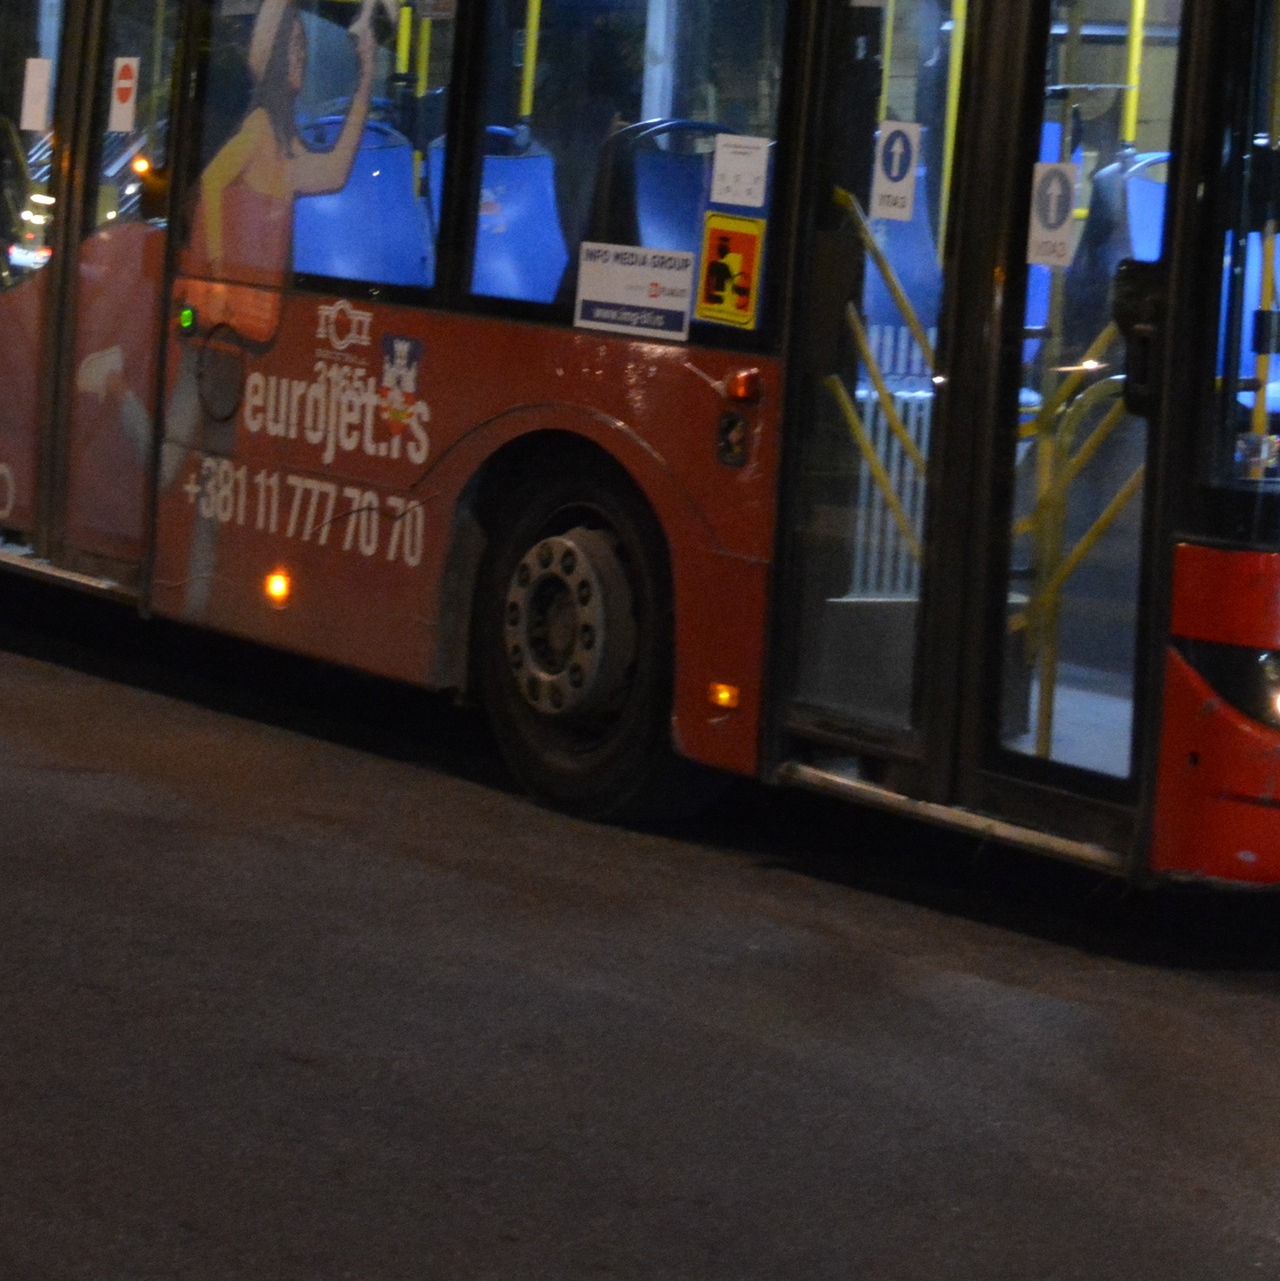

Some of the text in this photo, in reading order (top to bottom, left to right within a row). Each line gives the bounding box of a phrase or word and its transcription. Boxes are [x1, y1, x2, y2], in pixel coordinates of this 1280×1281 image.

[650, 253, 691, 271] GROUP
[183, 456, 425, 567] +381 11 777 70 70
